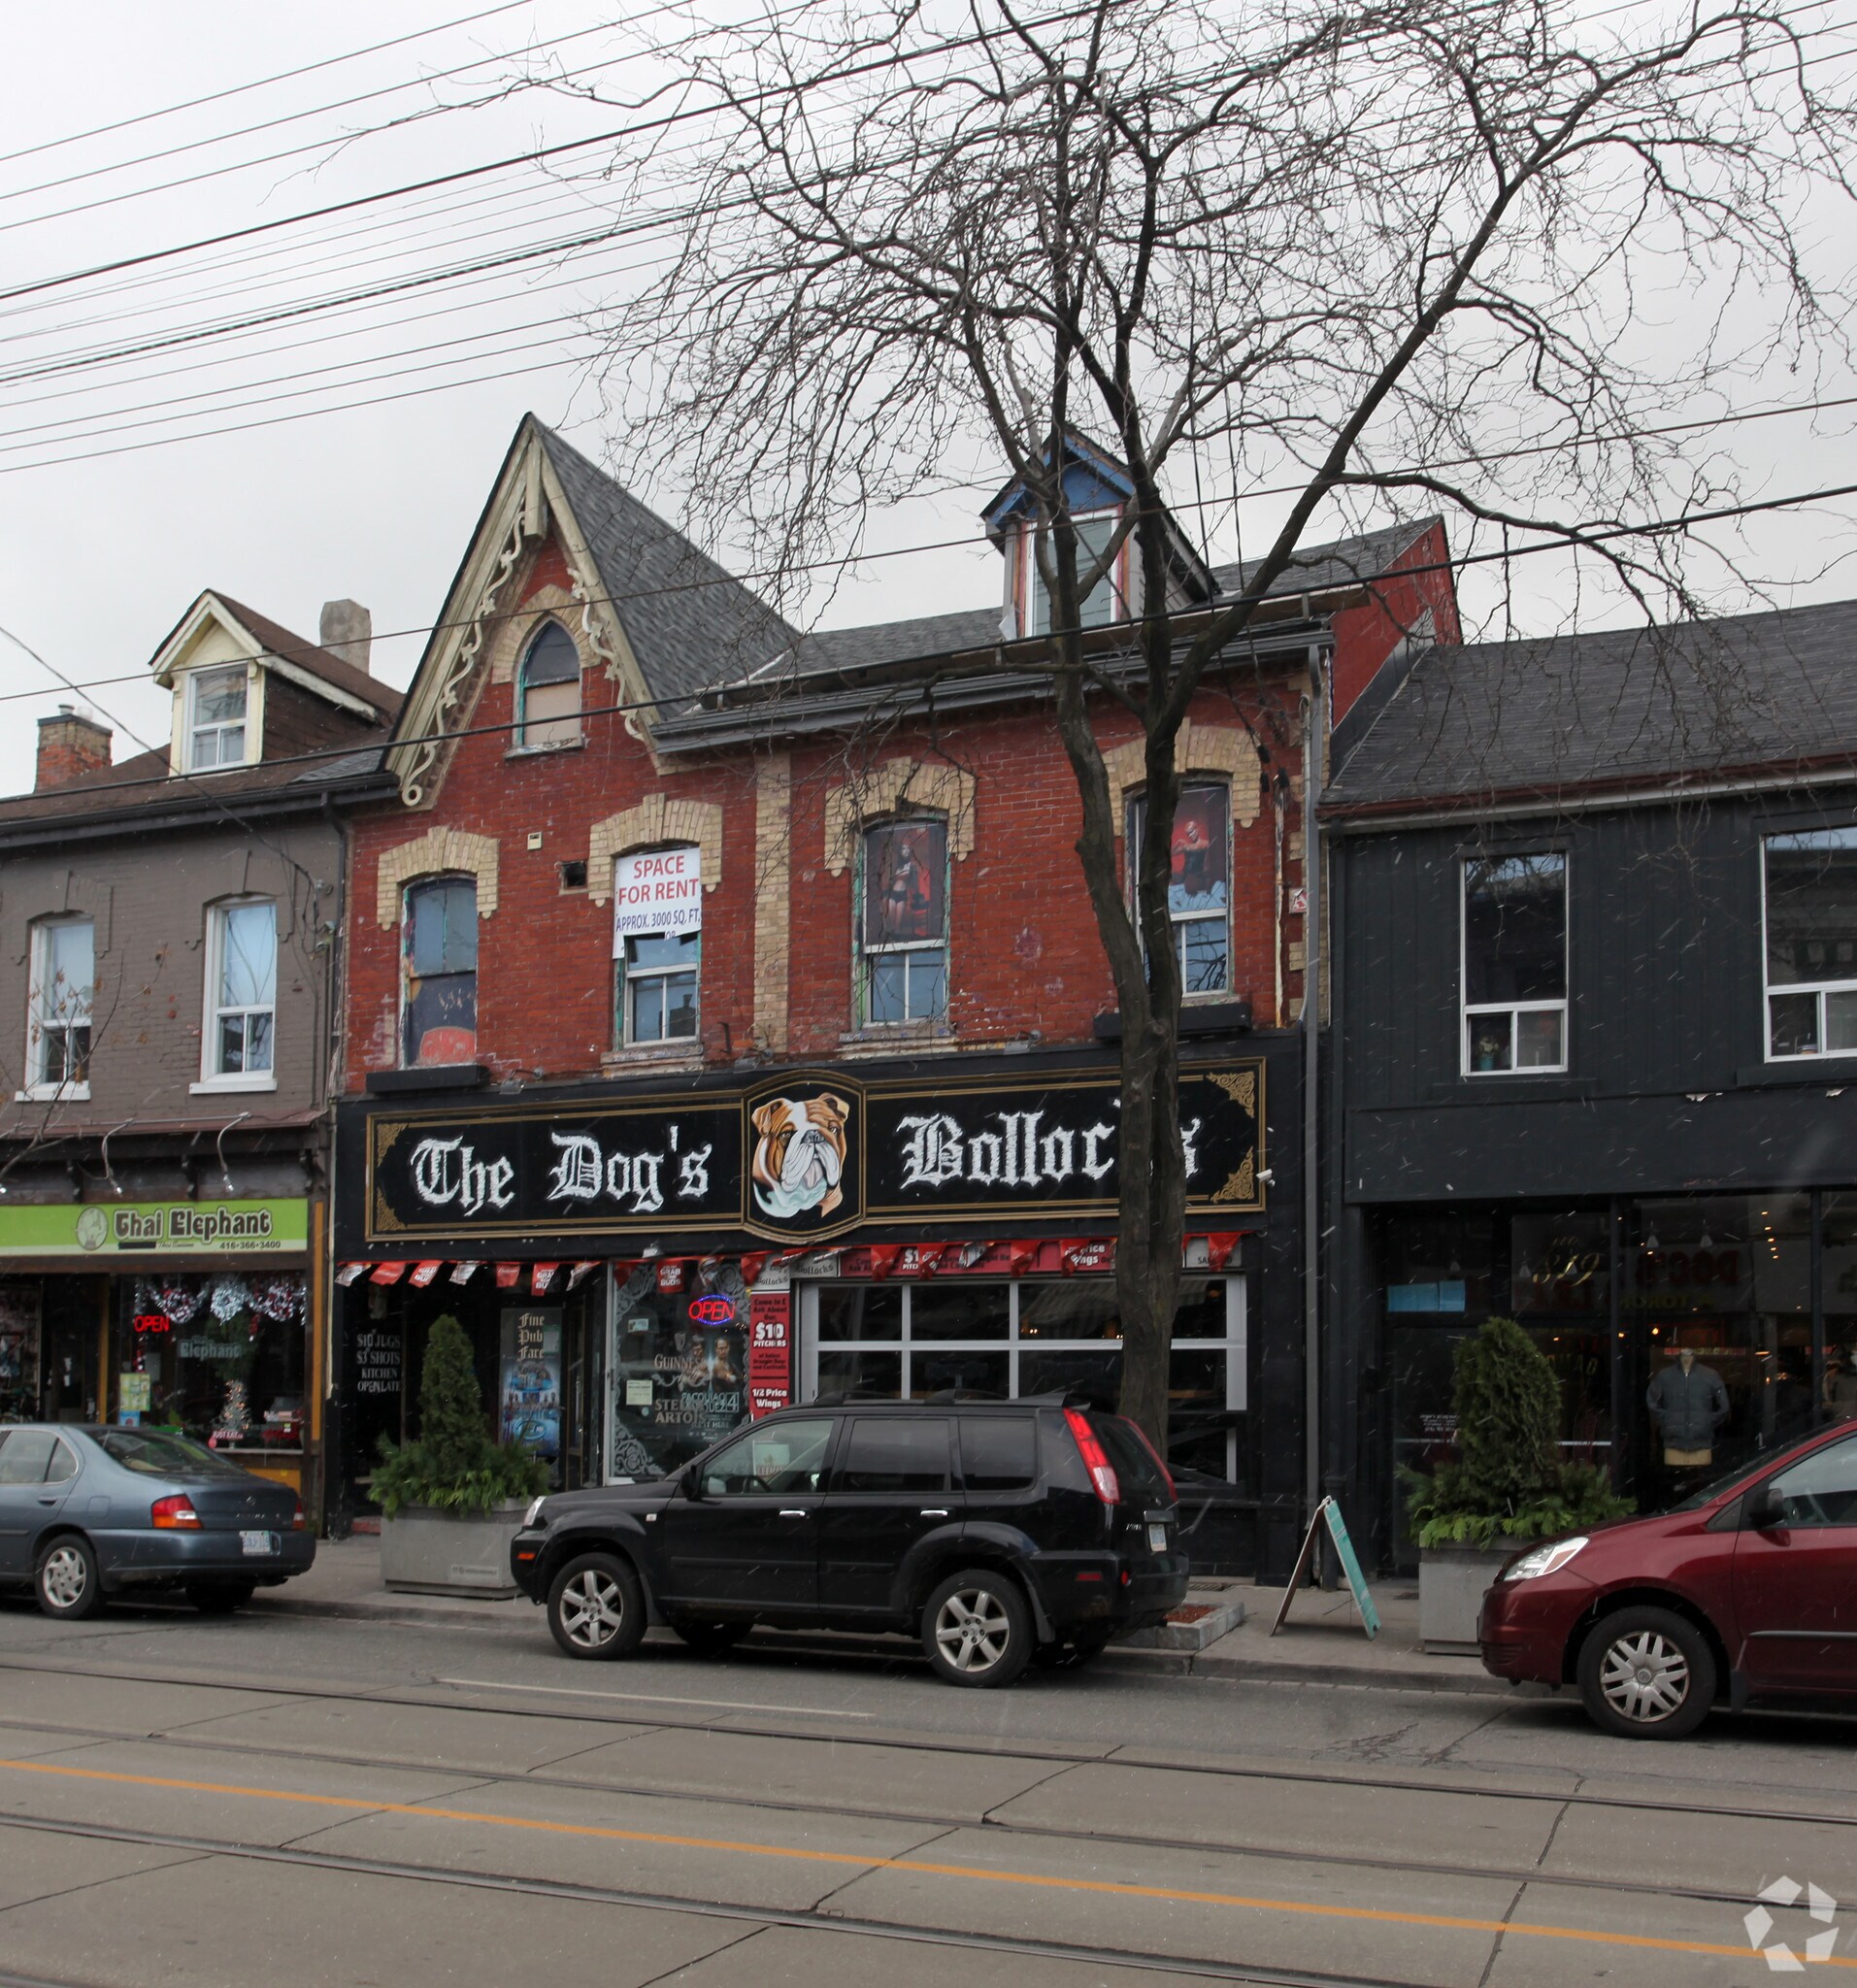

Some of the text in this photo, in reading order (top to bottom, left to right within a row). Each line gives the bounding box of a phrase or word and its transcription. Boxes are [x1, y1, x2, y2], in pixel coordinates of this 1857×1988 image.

[634, 855, 684, 878] SPACE
[618, 878, 699, 906] FOR RENT
[615, 908, 701, 932] APPROX. 3000 SQ. FT.
[411, 1099, 1202, 1216] The Dog's Bollocs
[114, 1206, 273, 1244] Thai Elephant
[905, 1248, 918, 1264] $1
[688, 1301, 736, 1320] OPEN
[133, 1315, 170, 1333] OPEN
[517, 1312, 545, 1329] Fine
[517, 1329, 543, 1345] Pub
[755, 1321, 784, 1340] $10
[180, 1339, 242, 1360] Elephant
[370, 1350, 401, 1365] SHOTS
[516, 1345, 544, 1362] Fare
[362, 1368, 398, 1379] KITCHEN
[752, 1388, 787, 1397] 1/2 Price
[756, 1399, 781, 1408] Wings
[655, 1411, 706, 1424] ARTOIS
